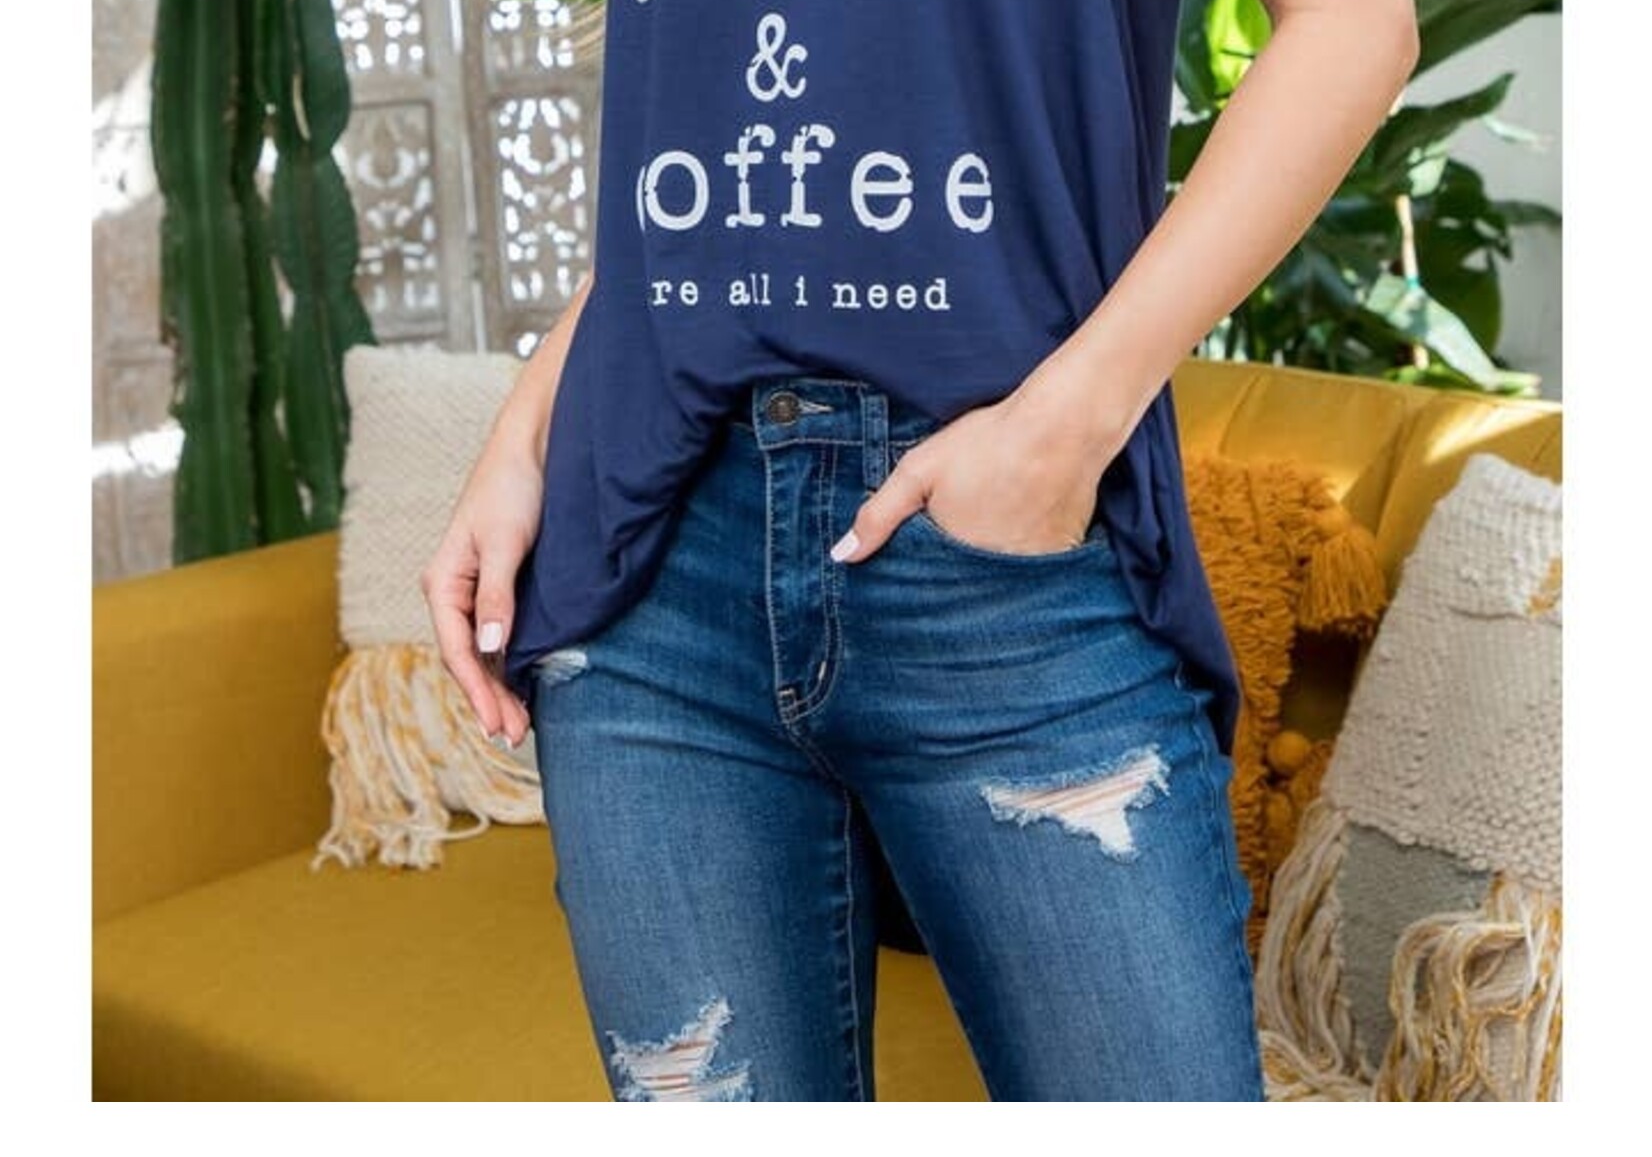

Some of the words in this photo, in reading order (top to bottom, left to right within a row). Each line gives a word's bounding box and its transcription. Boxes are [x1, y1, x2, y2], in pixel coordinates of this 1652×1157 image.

[746, 13, 809, 102] &
[636, 123, 994, 234] offee
[651, 280, 700, 307] re
[728, 274, 772, 306] all
[795, 275, 809, 307] i
[832, 278, 951, 310] need
